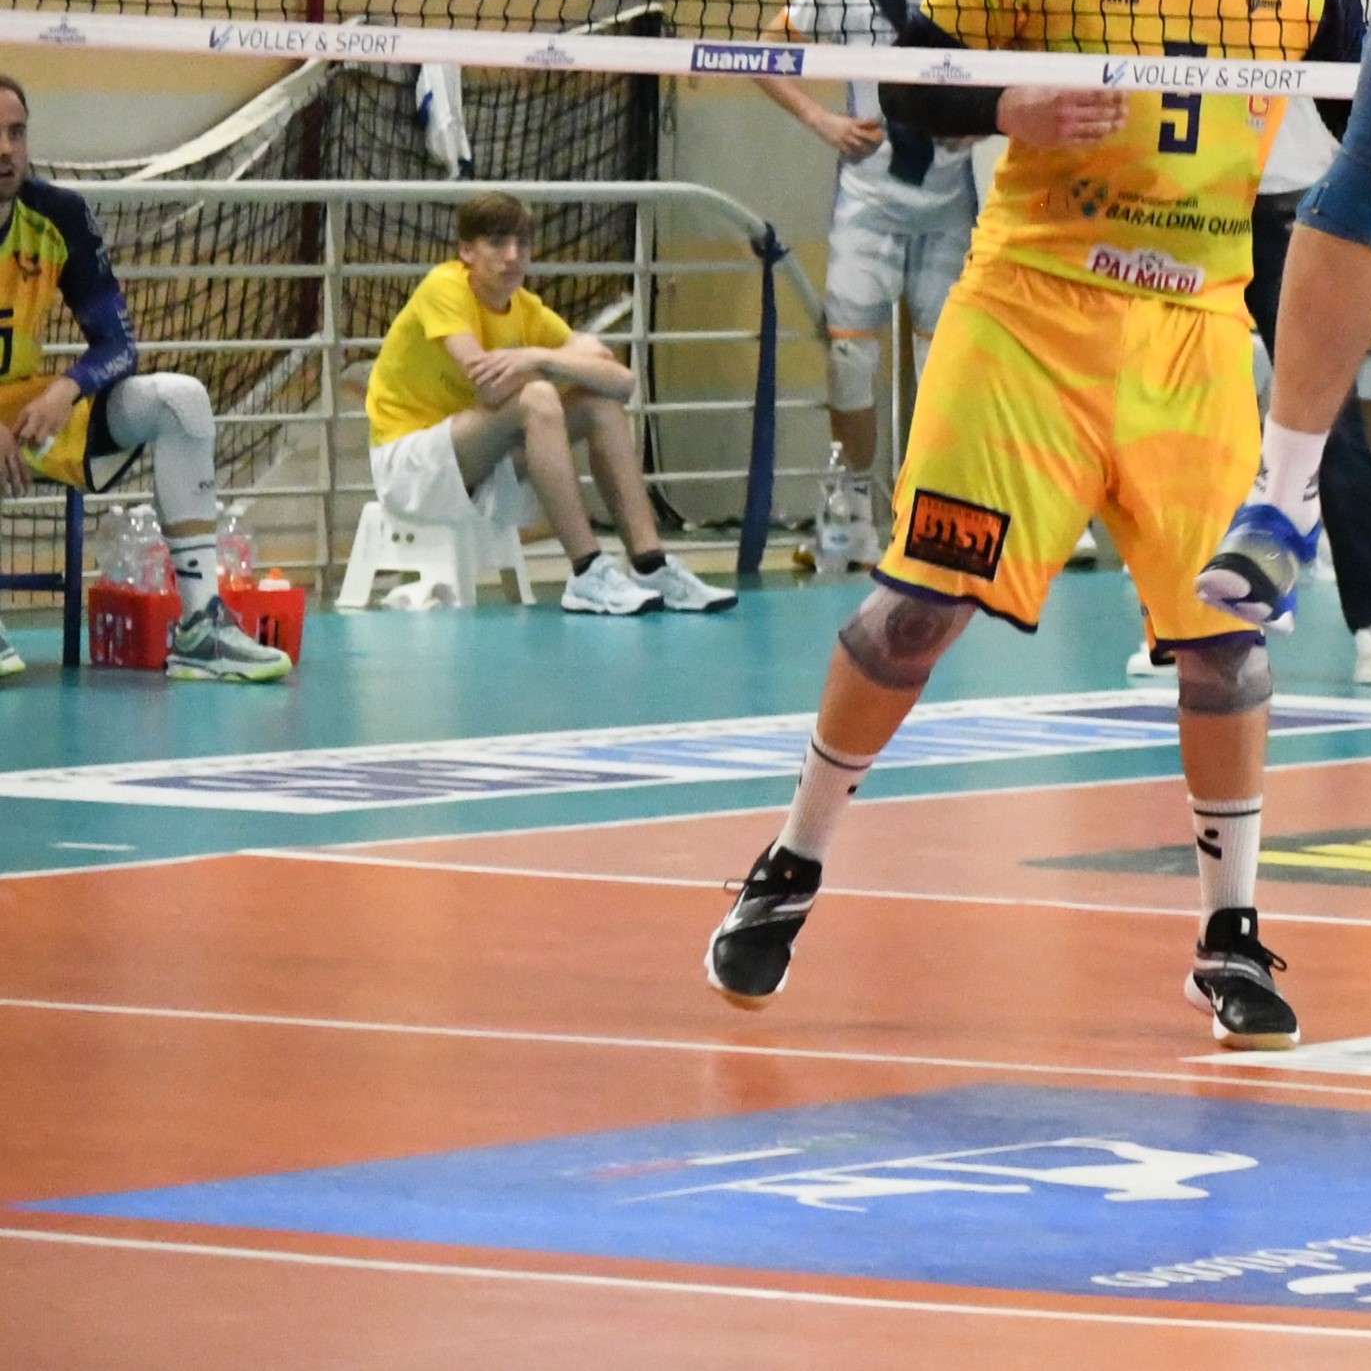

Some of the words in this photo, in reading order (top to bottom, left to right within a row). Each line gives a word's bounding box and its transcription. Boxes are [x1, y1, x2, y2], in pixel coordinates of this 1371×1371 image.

[236, 28, 308, 52] VOLLEY
[315, 29, 328, 53] &
[336, 31, 400, 56] SPORT
[1133, 65, 1210, 87] VOLLEY
[1216, 66, 1230, 87] &
[1237, 68, 1307, 90] SPORT
